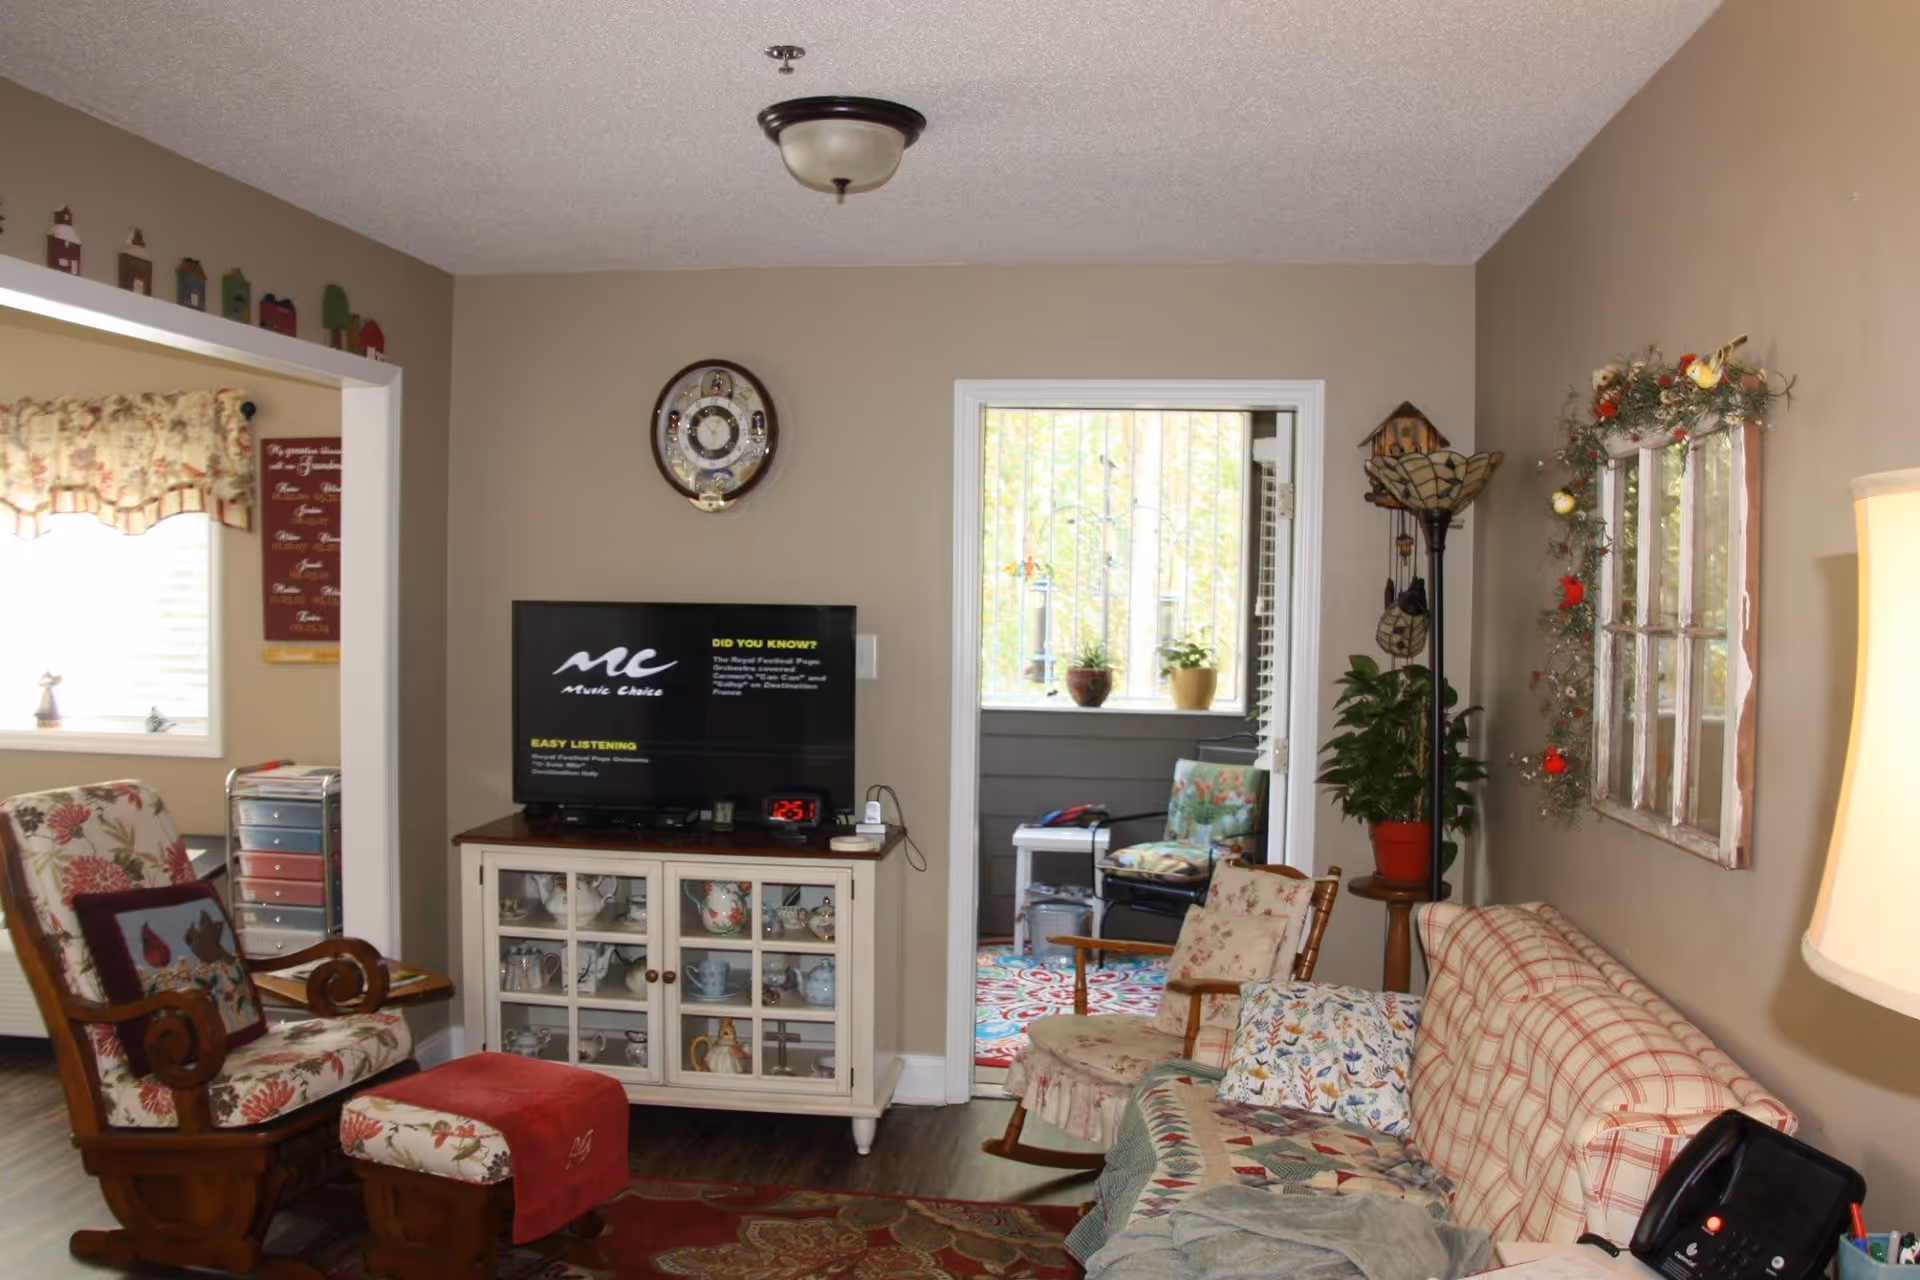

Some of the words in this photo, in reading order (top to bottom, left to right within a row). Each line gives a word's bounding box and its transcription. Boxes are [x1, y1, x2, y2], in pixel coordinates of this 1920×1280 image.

[712, 638, 734, 648] DID
[736, 638, 763, 649] YOU
[767, 639, 818, 649] KNOW?
[713, 656, 728, 664] The
[731, 656, 756, 665] Royal
[757, 657, 794, 665] Festival
[713, 664, 756, 672] Orchestra
[560, 684, 611, 696] Music
[617, 685, 664, 697] Choice
[531, 739, 567, 749] EASY
[570, 740, 638, 751] LISTENING
